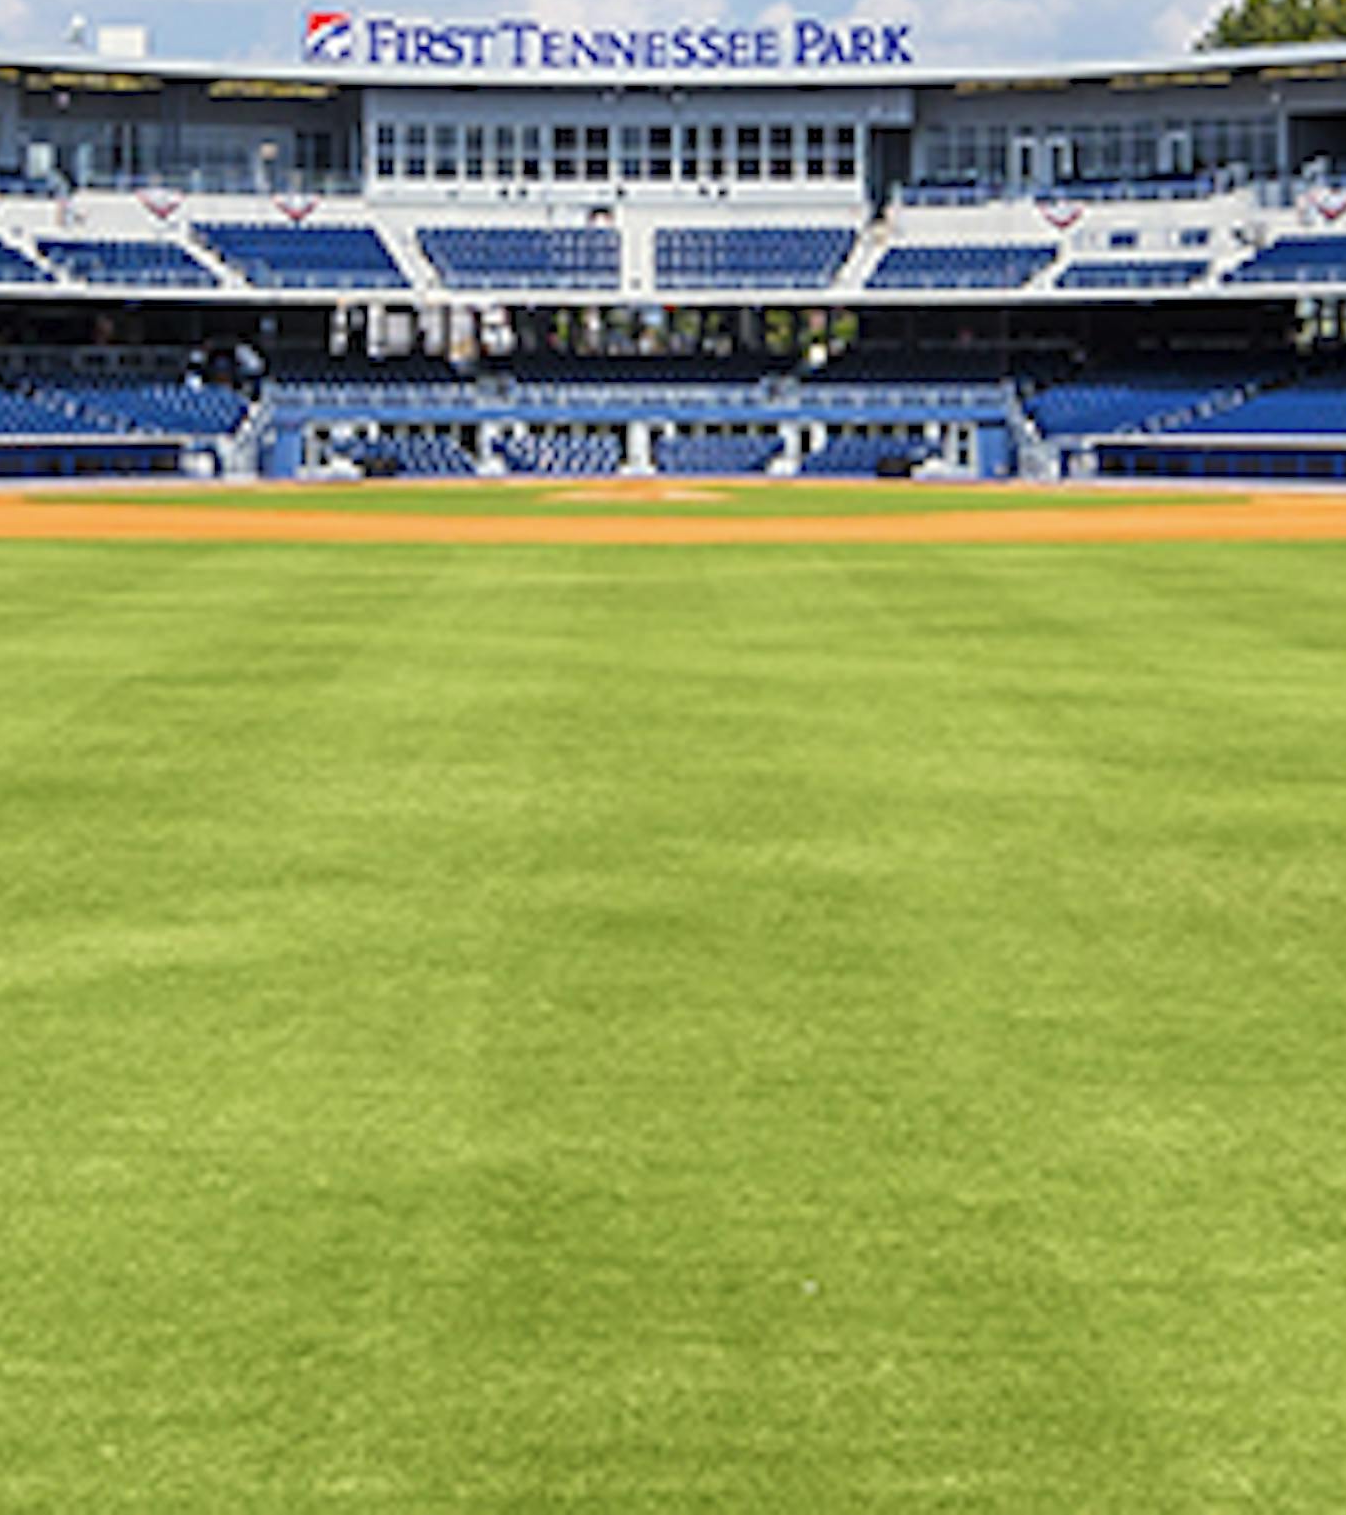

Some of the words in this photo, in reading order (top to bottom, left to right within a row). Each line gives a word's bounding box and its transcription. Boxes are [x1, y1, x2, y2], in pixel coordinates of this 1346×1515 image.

[367, 20, 496, 66] FIRST
[499, 20, 781, 67] TENNESSEE
[793, 19, 913, 66] PARK
